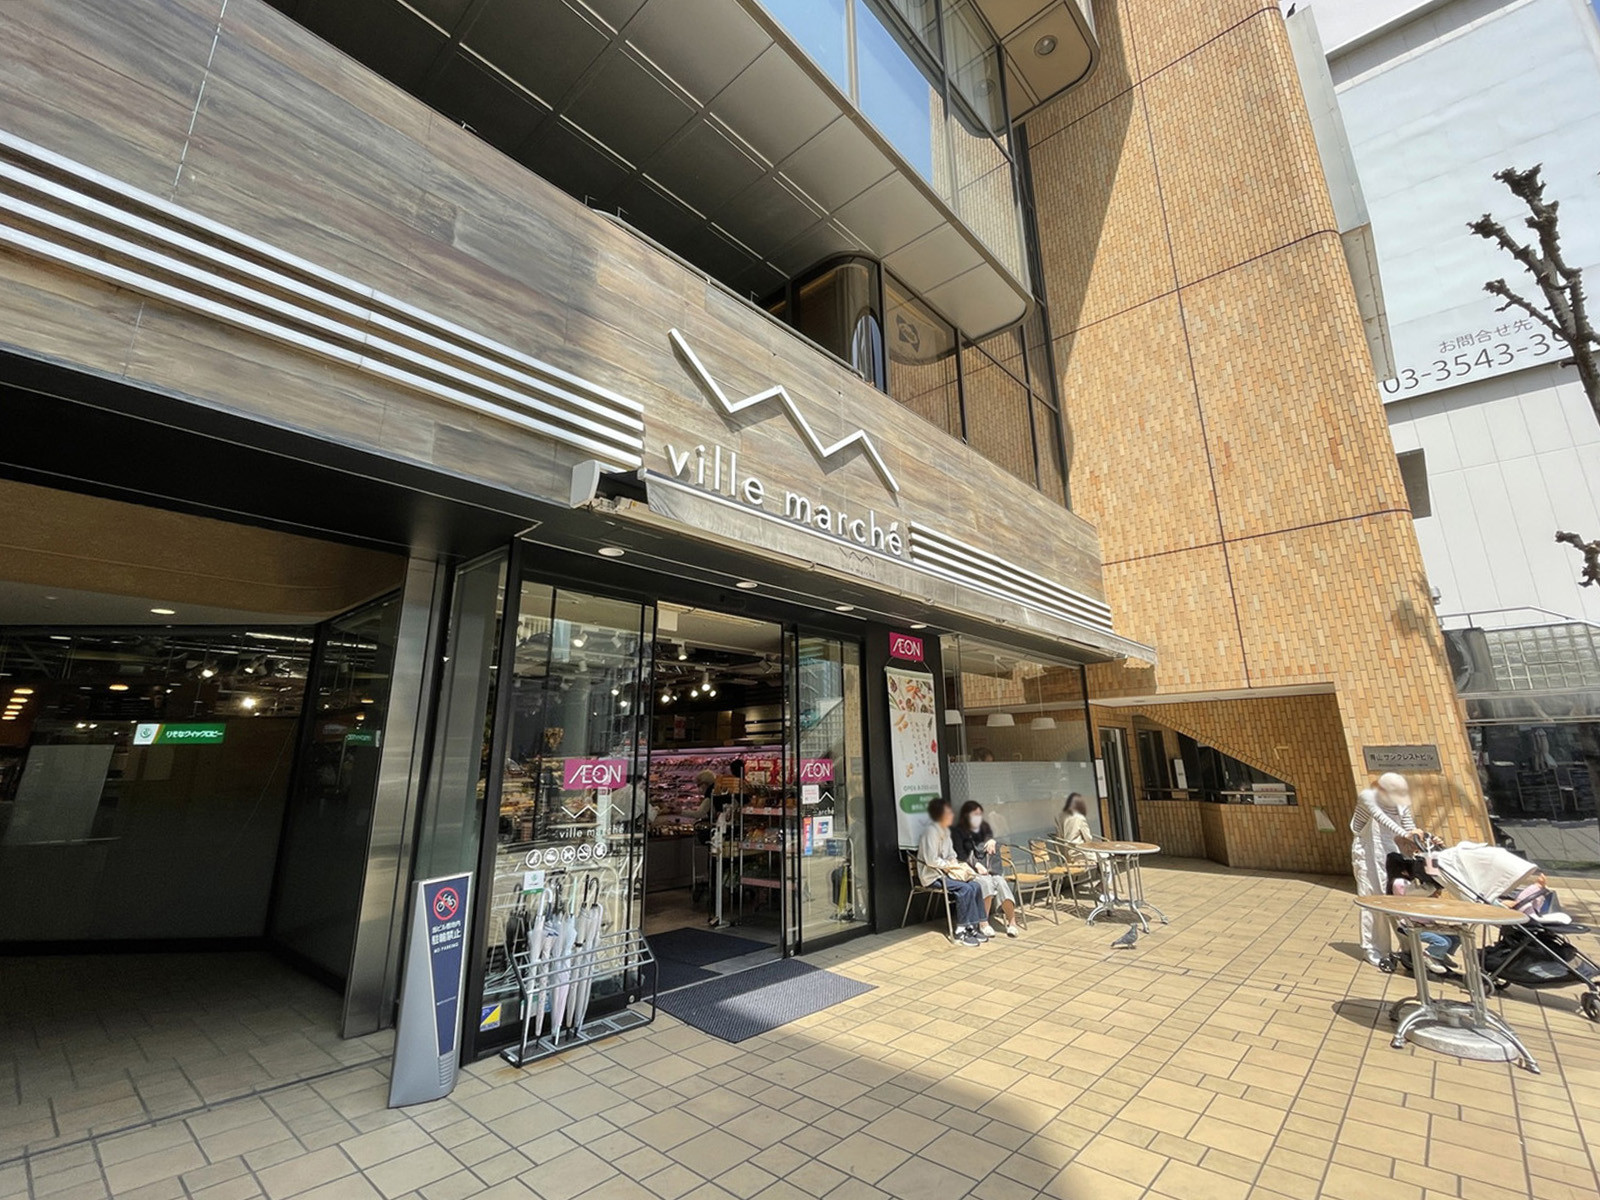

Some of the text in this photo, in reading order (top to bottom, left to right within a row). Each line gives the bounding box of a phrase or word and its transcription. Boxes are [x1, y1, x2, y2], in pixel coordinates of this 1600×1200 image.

[1438, 319, 1534, 354] お問合せ先
[664, 445, 902, 556] ville marché
[559, 827, 583, 838] ville
